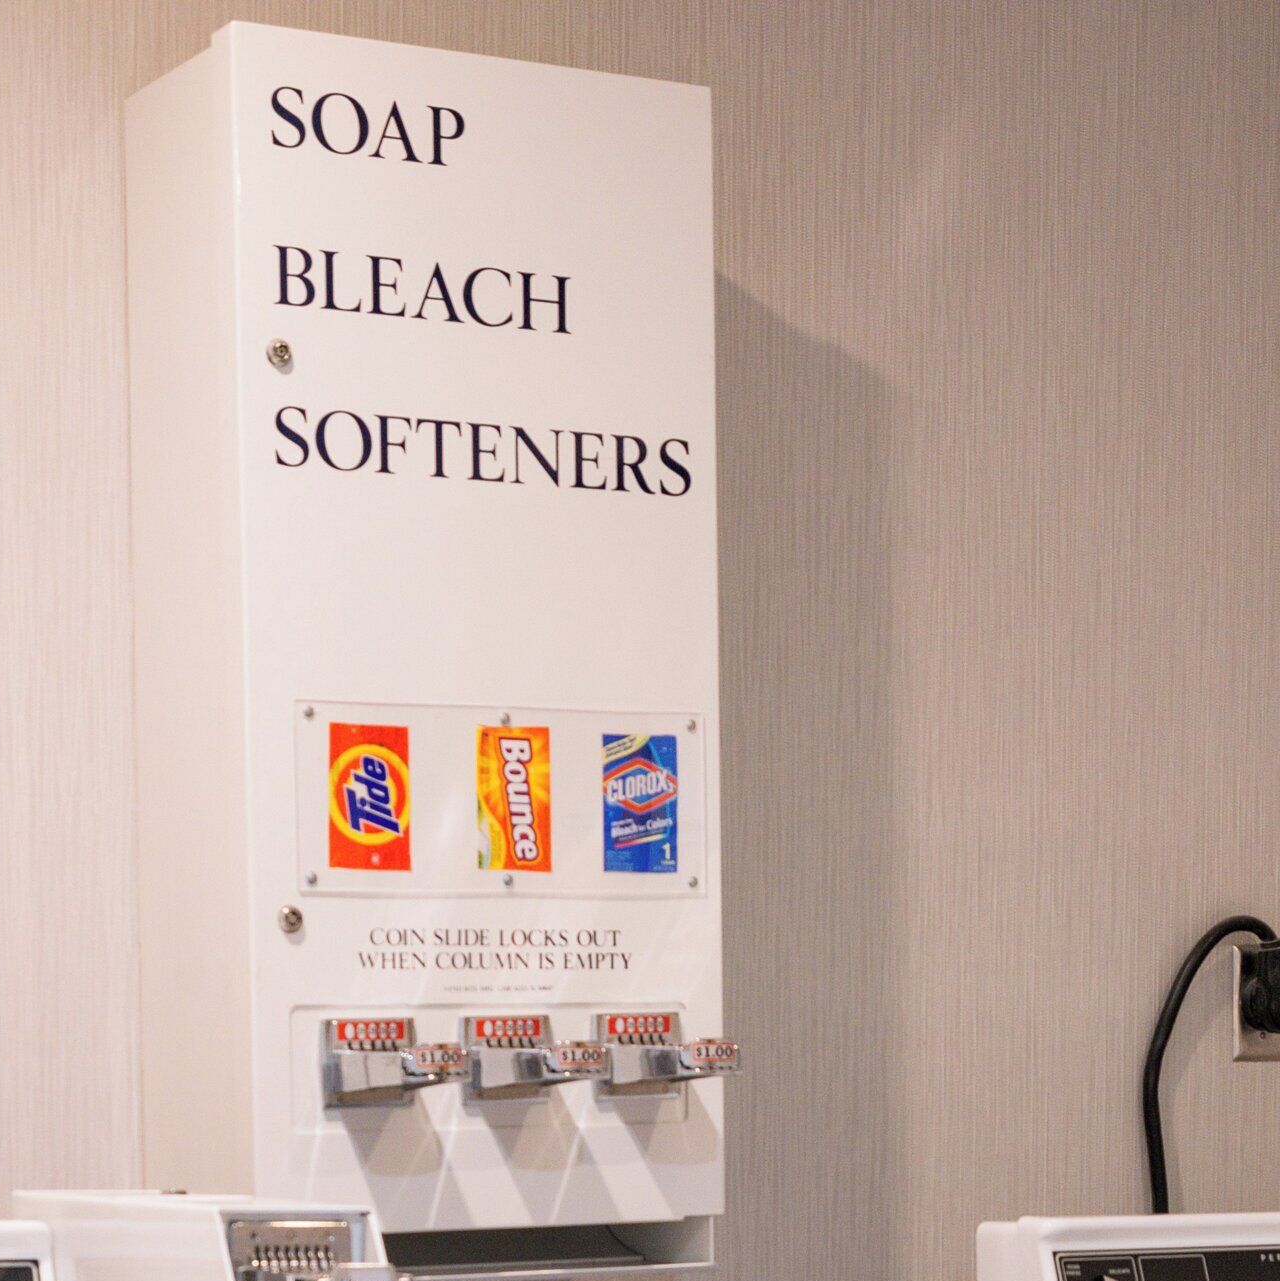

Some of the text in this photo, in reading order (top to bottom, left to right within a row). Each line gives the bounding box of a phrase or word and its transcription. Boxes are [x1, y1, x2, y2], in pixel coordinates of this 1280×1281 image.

[271, 86, 465, 166] SOAP
[273, 244, 572, 335] BLEACH
[274, 405, 693, 497] SOFTENERS
[344, 754, 402, 835] Tide
[606, 769, 669, 802] CLOROX
[499, 737, 540, 861] Bounce
[662, 842, 671, 860] 1
[370, 927, 622, 947] COIN SLIDE LOCKS OUT
[358, 951, 633, 970] WHEN COLUMN IS EMPTY
[421, 1050, 459, 1064] $1.00
[562, 1050, 601, 1063] $1.00
[696, 1046, 734, 1058] $1.00
